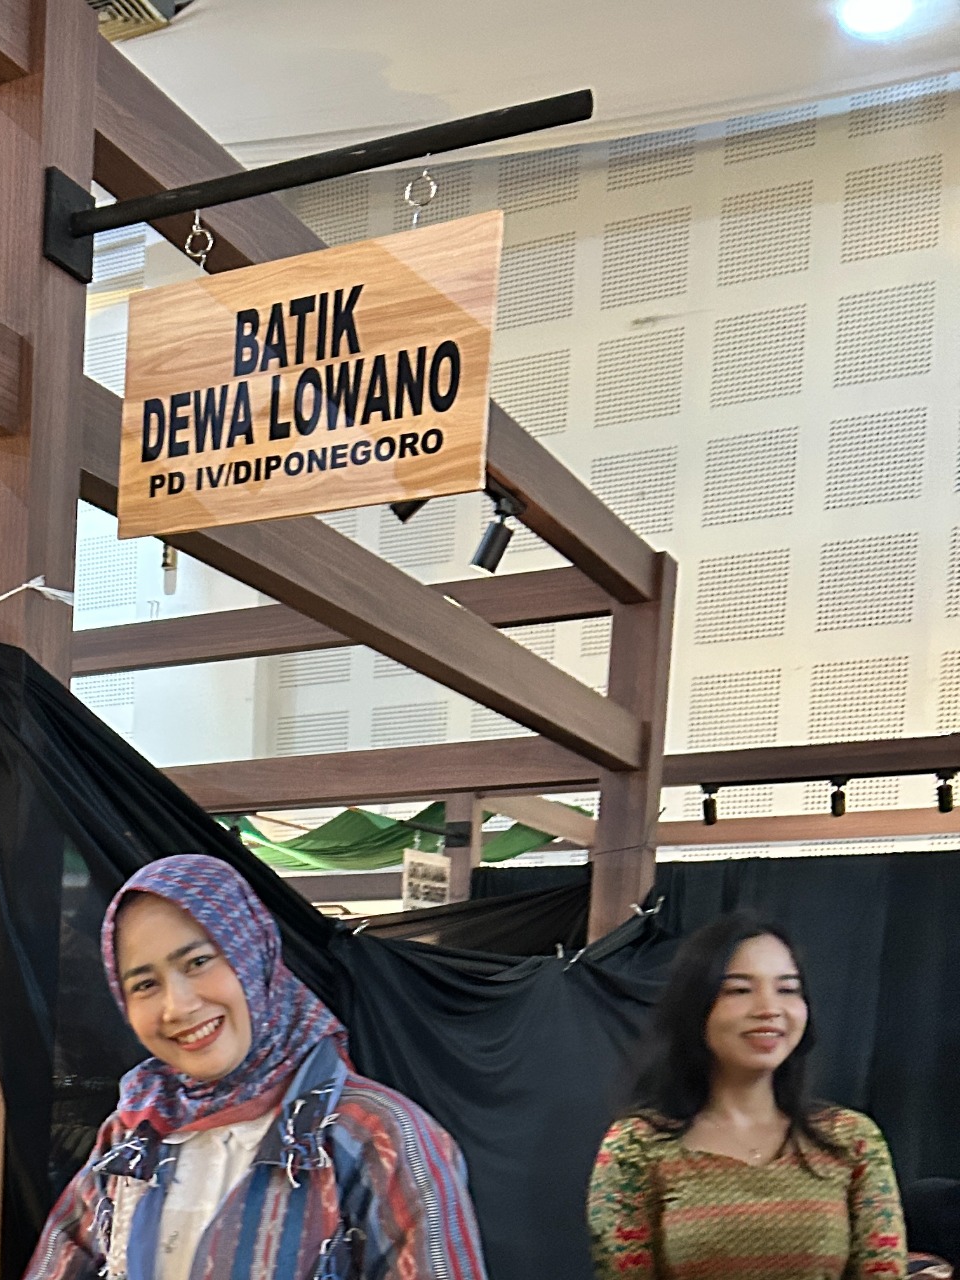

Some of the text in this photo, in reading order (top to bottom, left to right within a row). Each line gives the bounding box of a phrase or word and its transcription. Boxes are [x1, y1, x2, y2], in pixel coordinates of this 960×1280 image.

[234, 285, 364, 376] BATIK
[141, 341, 460, 462] DEWA LOWANO
[150, 429, 443, 497] PD IV/DIPONEGORO
